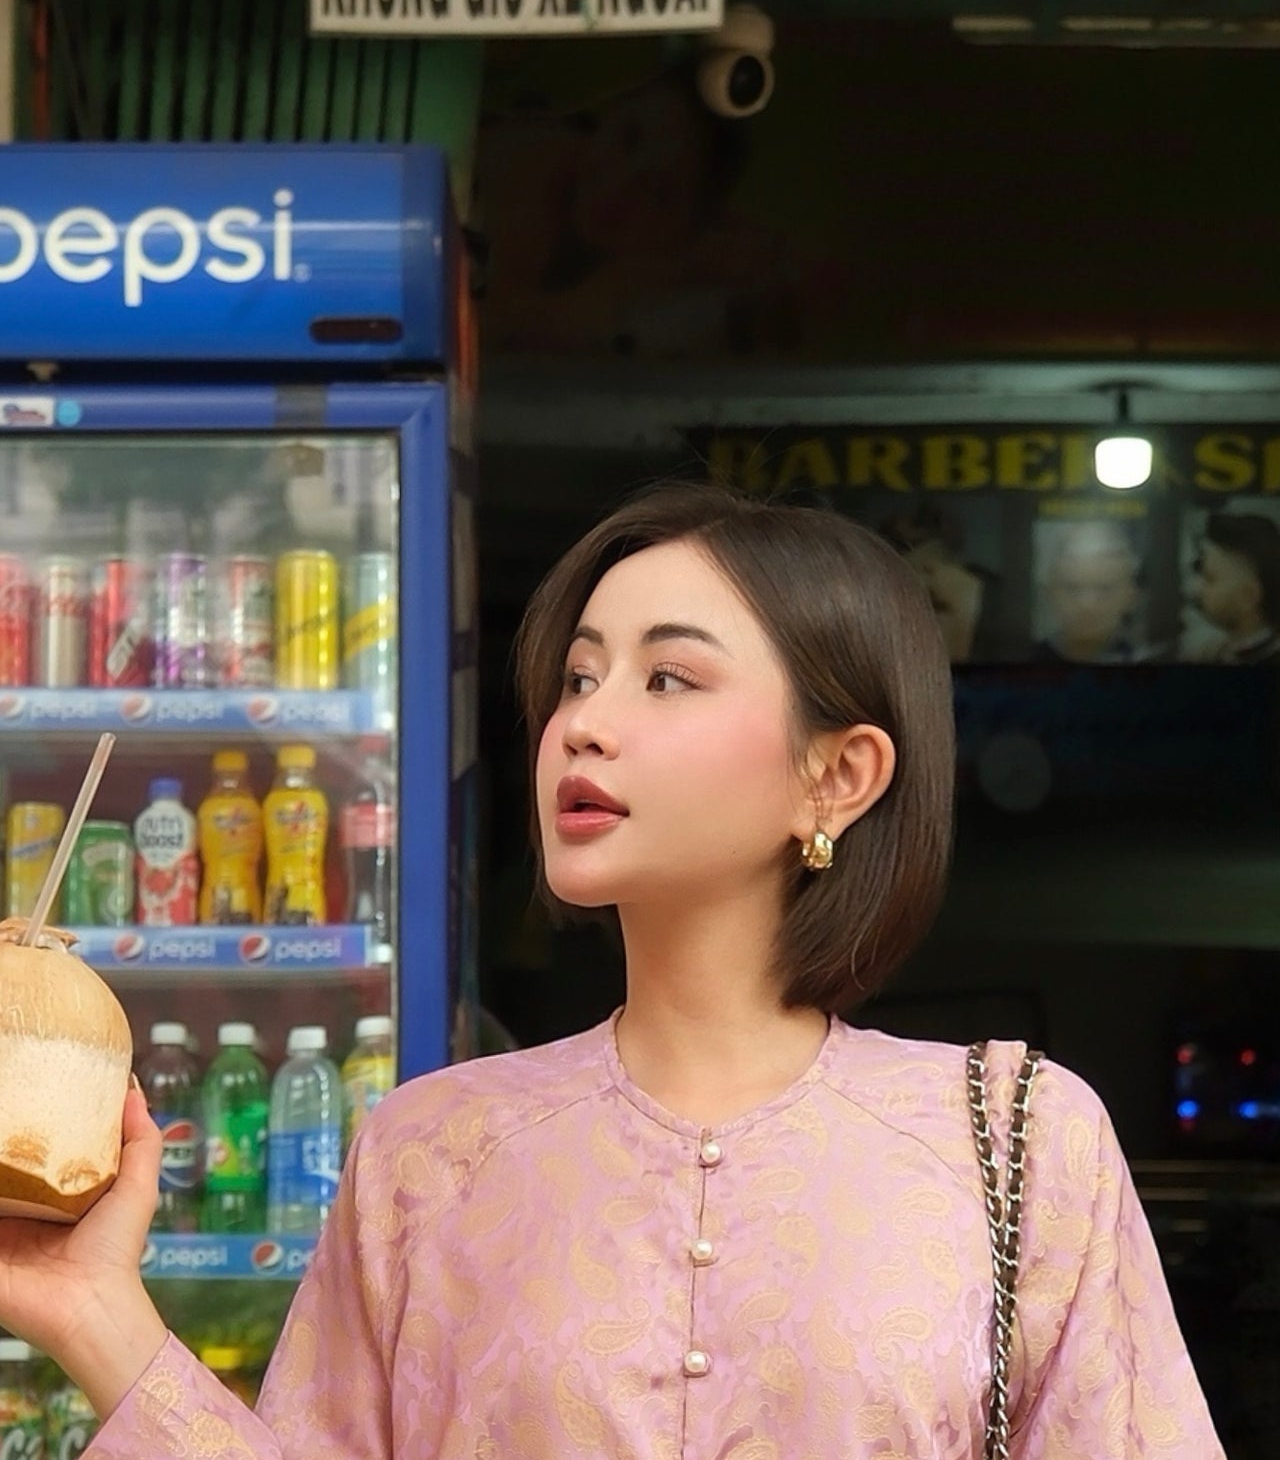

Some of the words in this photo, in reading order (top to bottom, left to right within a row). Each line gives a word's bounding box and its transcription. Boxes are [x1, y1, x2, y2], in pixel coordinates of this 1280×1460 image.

[149, 938, 216, 960] pepsi
[275, 938, 341, 960] pepsi
[161, 1246, 228, 1268] pepsi
